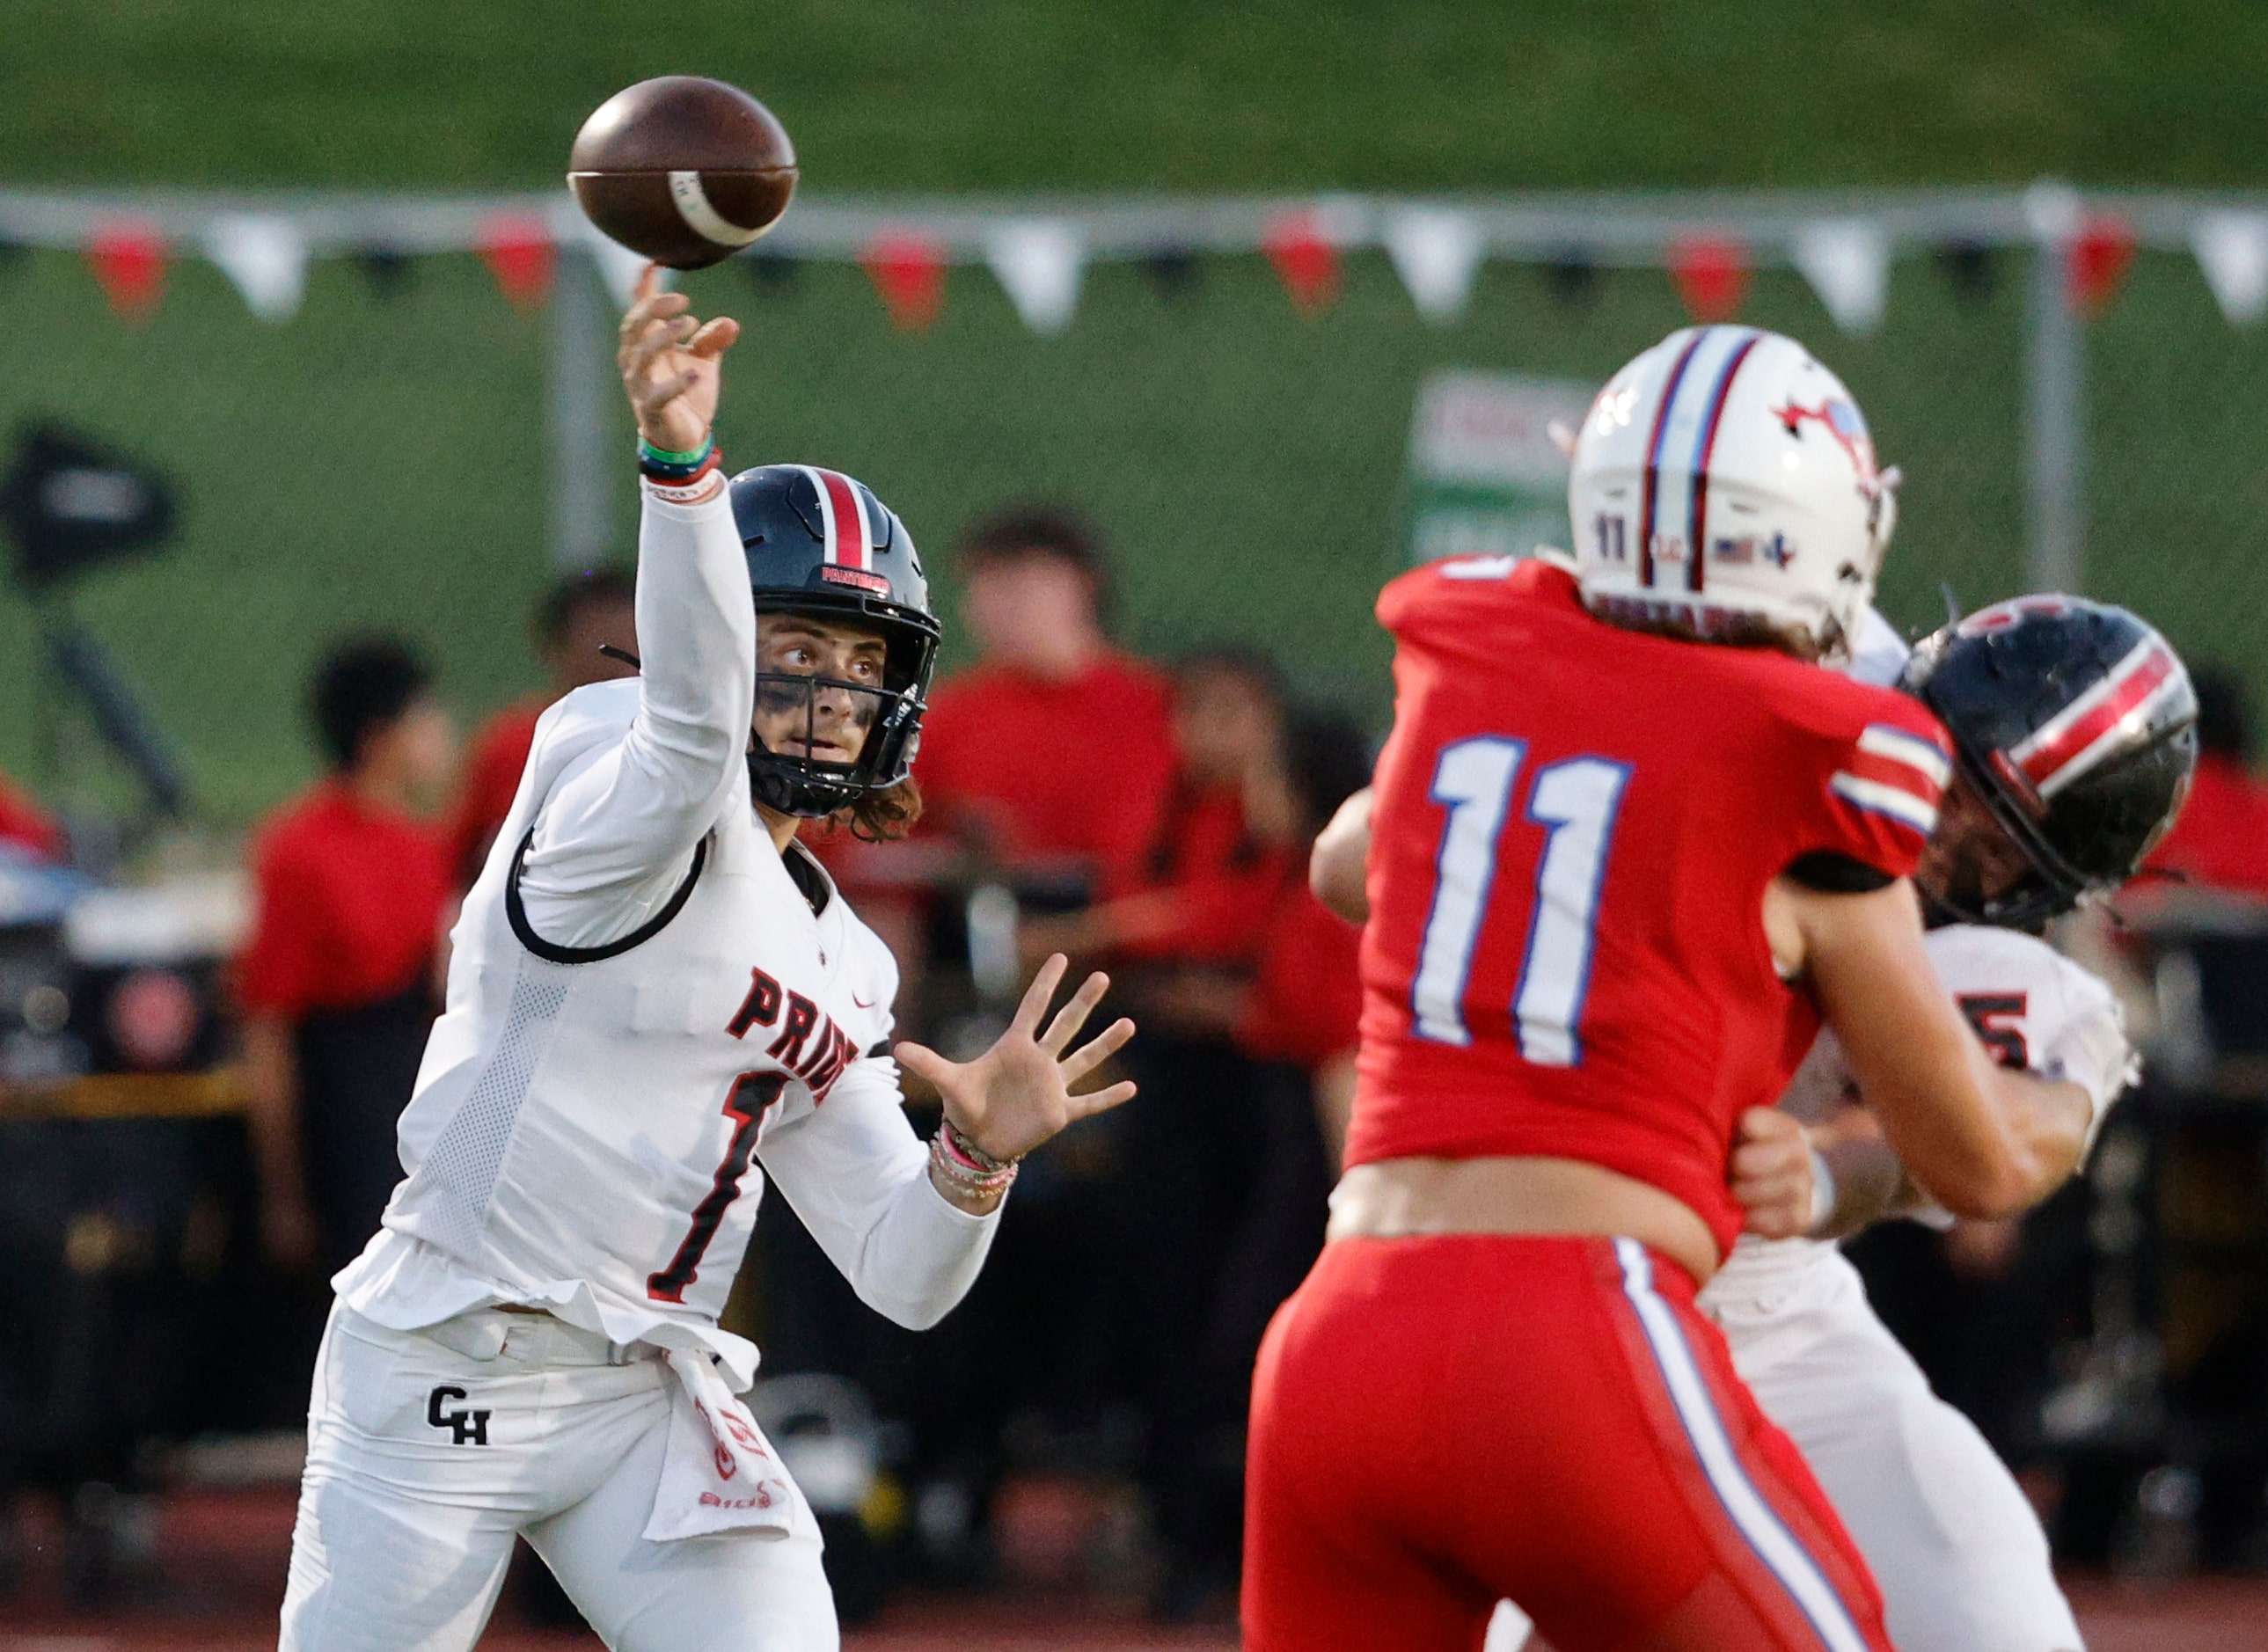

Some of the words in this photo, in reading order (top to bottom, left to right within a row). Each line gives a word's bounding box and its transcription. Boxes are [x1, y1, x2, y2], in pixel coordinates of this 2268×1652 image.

[1595, 509, 1626, 561] 11
[1408, 733, 1636, 1070] 11
[646, 1069, 794, 1305] 1
[427, 1384, 493, 1446] CH
